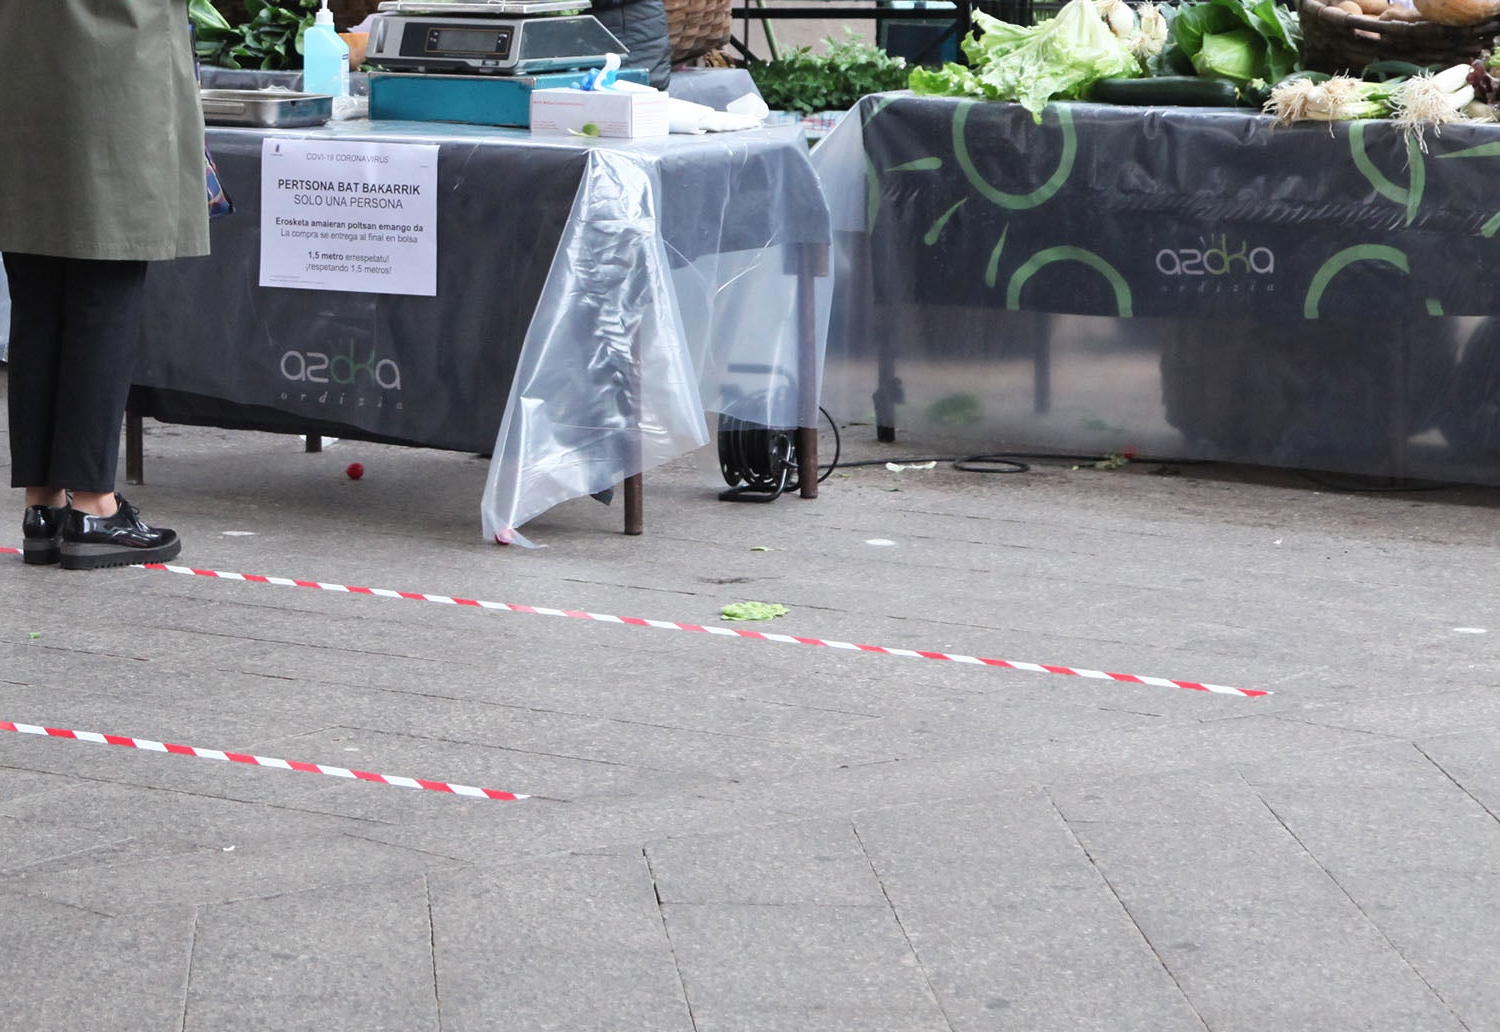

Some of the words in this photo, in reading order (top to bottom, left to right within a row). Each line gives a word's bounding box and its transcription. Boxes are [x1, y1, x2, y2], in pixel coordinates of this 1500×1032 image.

[278, 178, 335, 192] PERTSONA
[337, 182, 360, 193] BAT
[362, 182, 421, 196] BAKARRIK
[293, 194, 324, 207] SOLO
[325, 196, 348, 207] UNA
[349, 197, 404, 209] PERSONA
[275, 216, 310, 227] Erosketa
[310, 219, 346, 229] amaieran
[347, 221, 377, 231] poltsan
[378, 224, 412, 233] emango
[413, 224, 424, 232] da
[280, 229, 291, 237] La
[291, 230, 319, 239] compra
[330, 232, 359, 242] entrega
[359, 233, 367, 241] al
[367, 233, 385, 242] final
[397, 234, 419, 244] bolsa
[321, 252, 344, 261] metro
